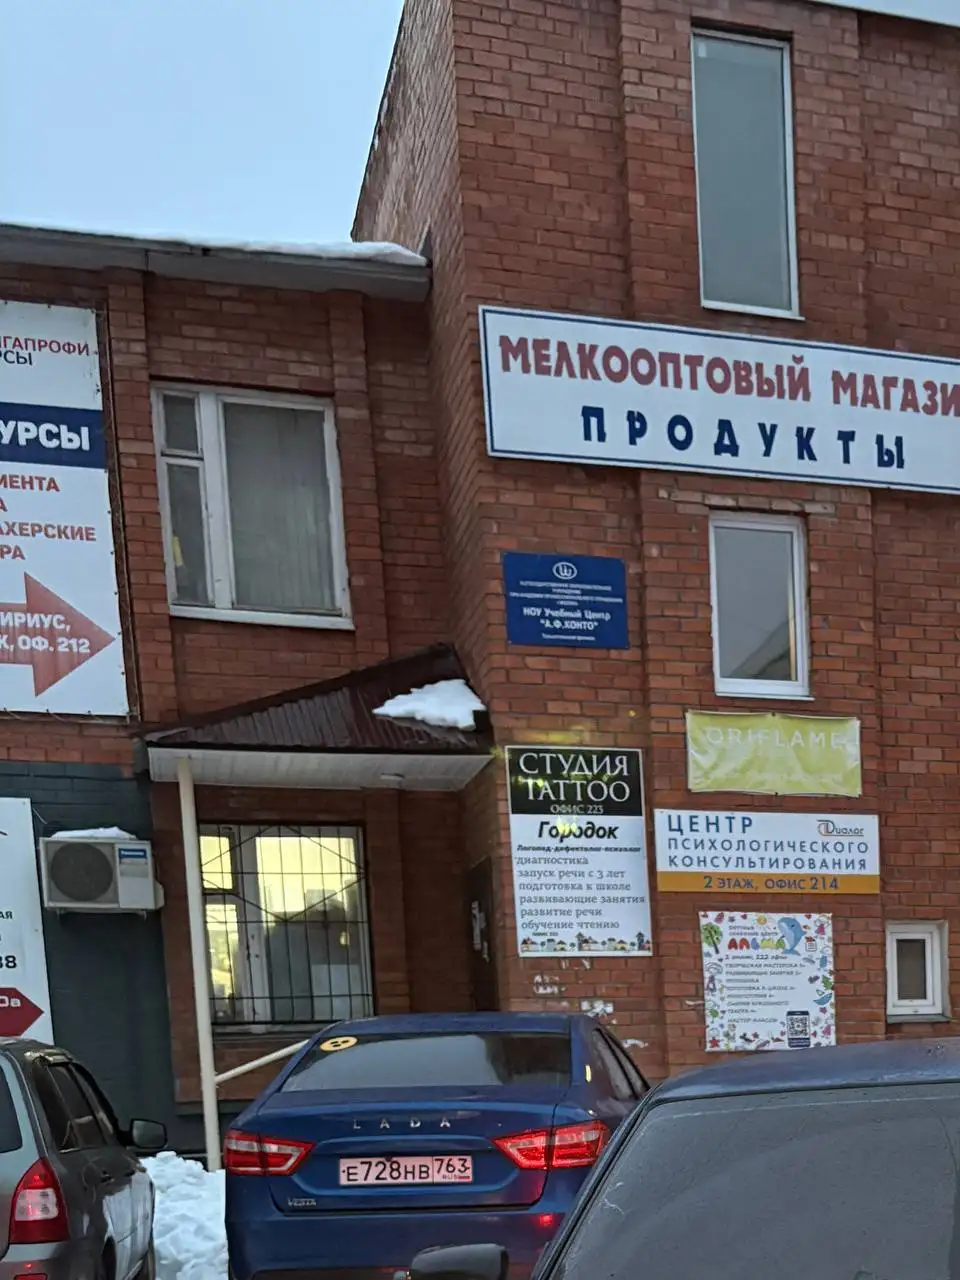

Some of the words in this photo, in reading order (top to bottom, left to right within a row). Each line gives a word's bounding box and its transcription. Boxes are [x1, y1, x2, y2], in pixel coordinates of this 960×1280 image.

[0, 335, 90, 356] ГАПРОФИ
[0, 350, 33, 366] СЫ
[500, 335, 812, 402] МЕЛКООПТОВЫЙ
[581, 405, 905, 469] ПРОДУКТЫ
[57, 637, 90, 653] 212
[707, 727, 846, 750] ORIFLAME
[519, 752, 629, 776] СТУДИЯ
[538, 821, 619, 843] Городок
[668, 814, 753, 836] ЦЕНТР
[668, 838, 869, 854] ПСИХОЛОГИЧЕСКОГО
[516, 856, 589, 866] диагностика
[668, 855, 867, 870] КОНСУЛЬТИРОВАНИЯ
[518, 870, 556, 879] запуск
[519, 882, 583, 892] подготовка
[596, 882, 631, 891] школе
[703, 876, 713, 888] 2
[716, 877, 759, 891] ЭТАЖ,
[764, 878, 805, 890] ОФИС
[809, 876, 838, 890] 214
[521, 907, 573, 918] развитие
[521, 920, 574, 931] обучение
[353, 1117, 451, 1129] LADA
[346, 1160, 430, 1182] Е728НВ
[434, 1157, 468, 1174] 763
